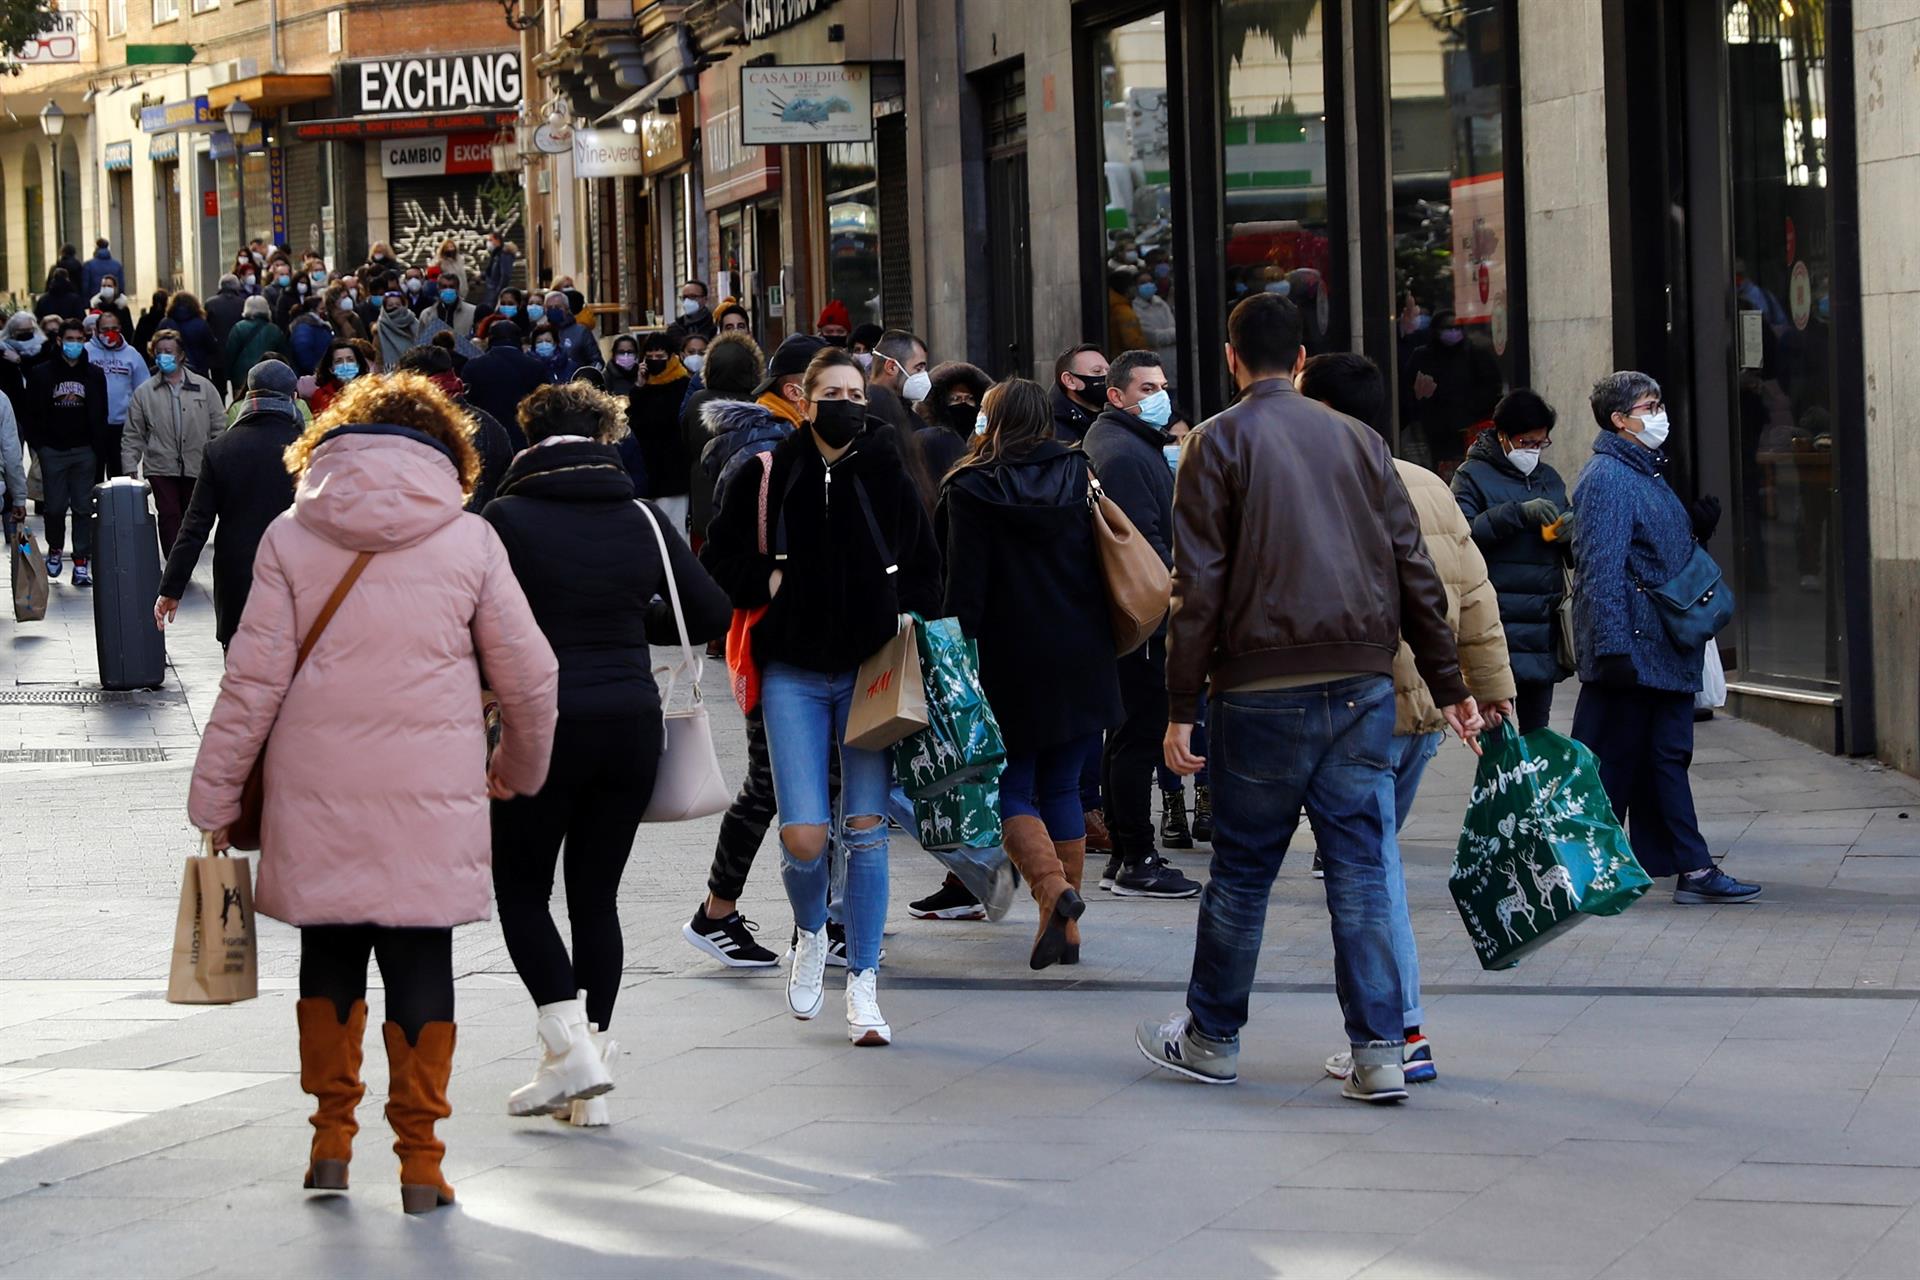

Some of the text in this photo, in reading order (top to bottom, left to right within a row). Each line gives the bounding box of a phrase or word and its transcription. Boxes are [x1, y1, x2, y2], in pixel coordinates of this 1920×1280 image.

[360, 53, 520, 110] EXCHANG
[749, 70, 863, 84] CASA DE DIEGO
[389, 147, 442, 165] CAMBIO
[454, 144, 493, 162] EXCH
[52, 381, 86, 399] LAKERS
[1164, 1040, 1183, 1061] N
